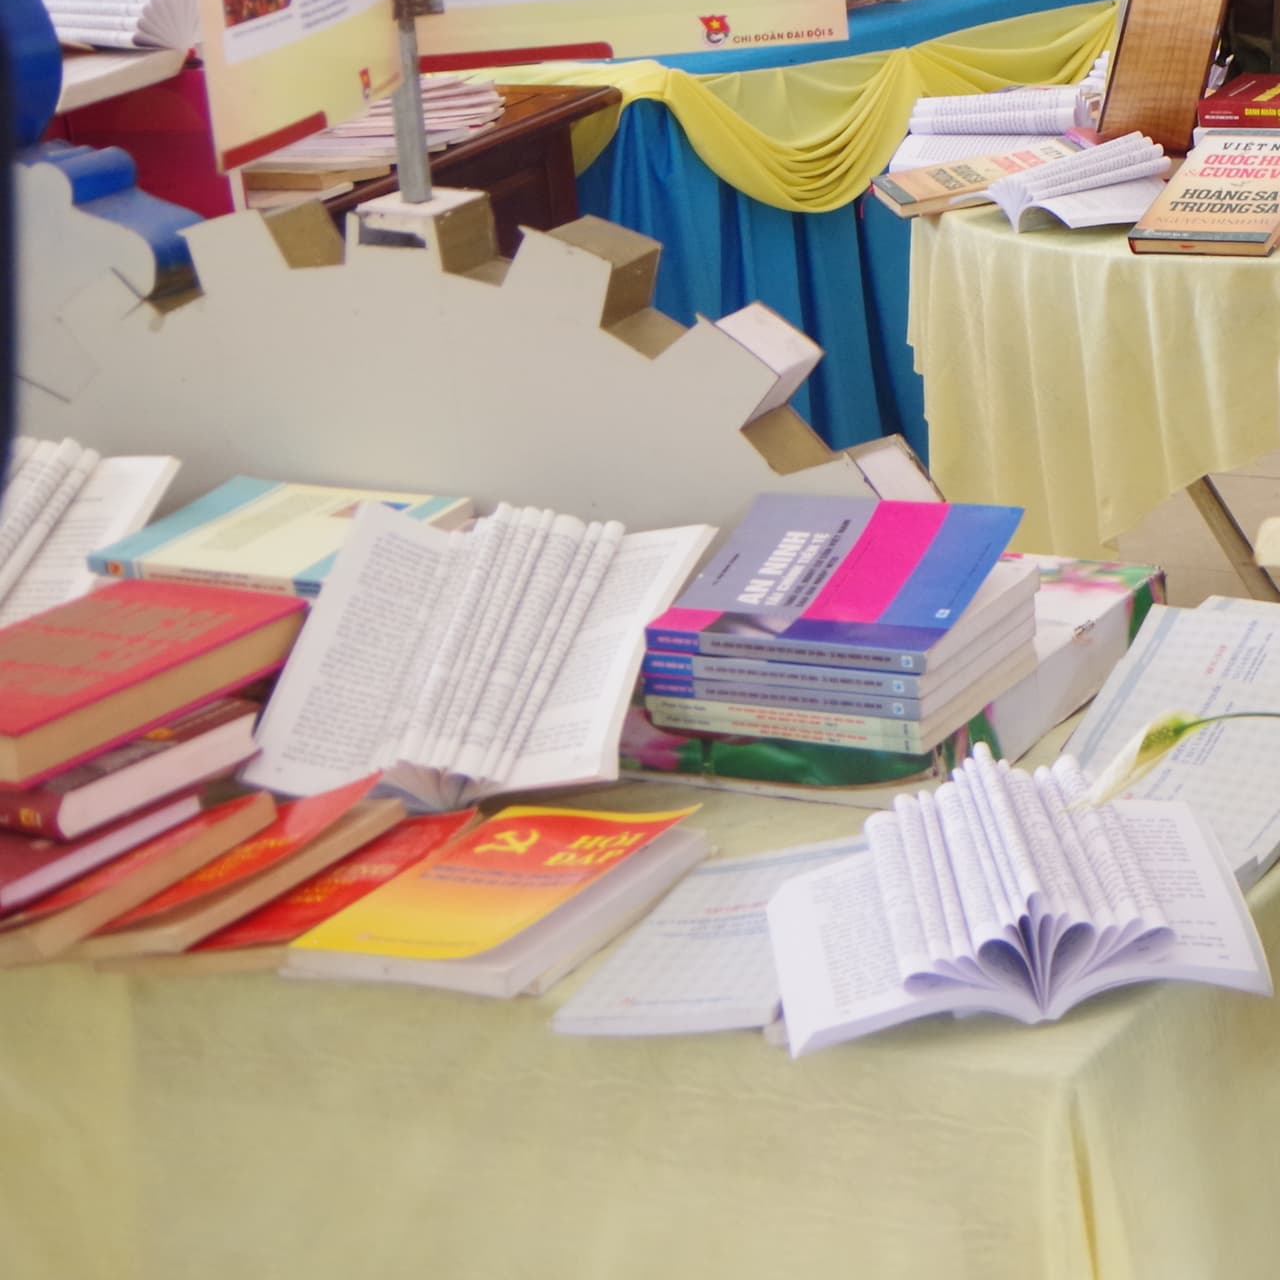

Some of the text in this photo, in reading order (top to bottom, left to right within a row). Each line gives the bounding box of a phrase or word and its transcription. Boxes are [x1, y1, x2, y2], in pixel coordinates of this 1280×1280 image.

[733, 34, 752, 44] CHI
[754, 31, 784, 43] ĐOÀN
[786, 30, 805, 41] ĐẠI
[807, 27, 826, 40] ĐỘI
[1223, 141, 1268, 152] VIỆT
[1204, 152, 1259, 167] QUỐC
[1198, 166, 1271, 179] CƯƠNG
[1179, 187, 1280, 201] HOÀNG SA
[1169, 201, 1280, 214] TRƯỜNG SA
[737, 531, 812, 605] AN NINH
[543, 847, 627, 867] ĐÁP
